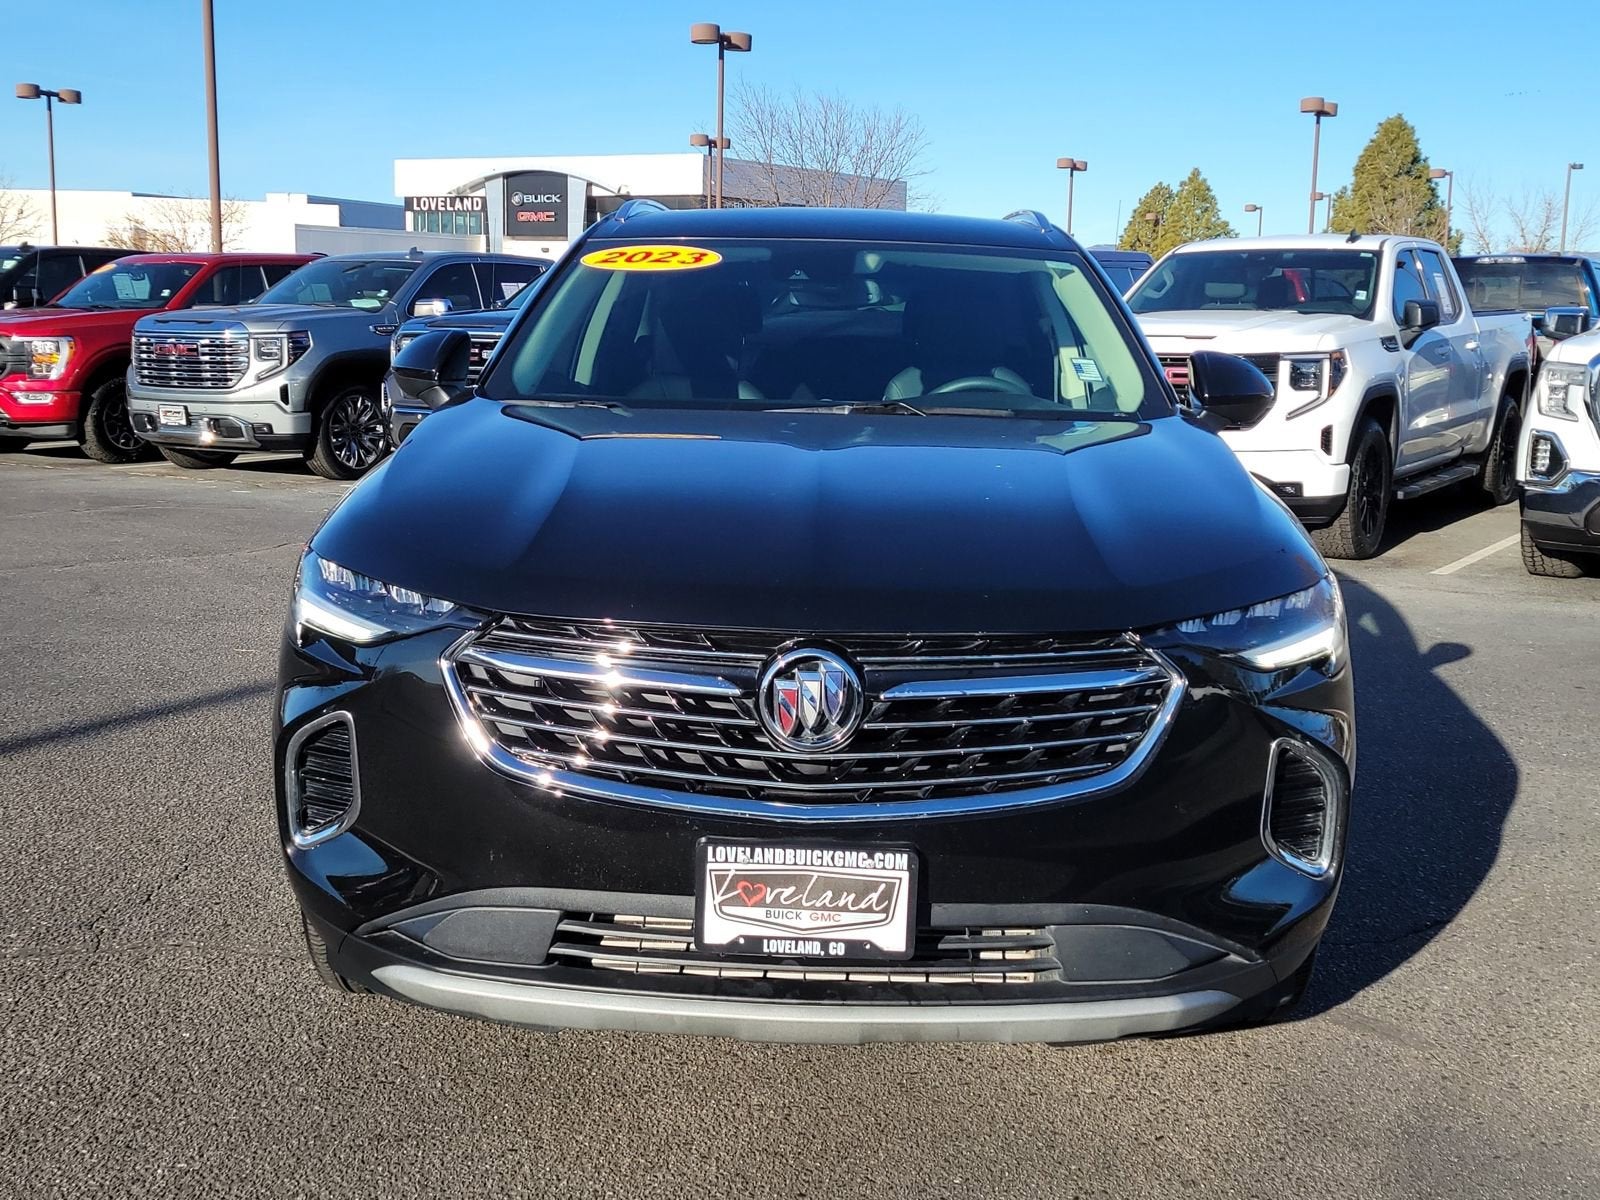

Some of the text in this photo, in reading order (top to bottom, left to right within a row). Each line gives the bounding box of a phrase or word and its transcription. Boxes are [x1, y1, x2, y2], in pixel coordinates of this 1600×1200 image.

[413, 197, 482, 211] LOVELAND
[523, 194, 562, 203] BUICK
[517, 211, 556, 222] GMC
[595, 251, 708, 264] 2023
[155, 344, 198, 355] GMC
[707, 846, 908, 870] LOVELANDBUICKGMC.COM
[765, 910, 841, 923] BUICK GMC
[763, 939, 845, 956] LOVELAND, CO
